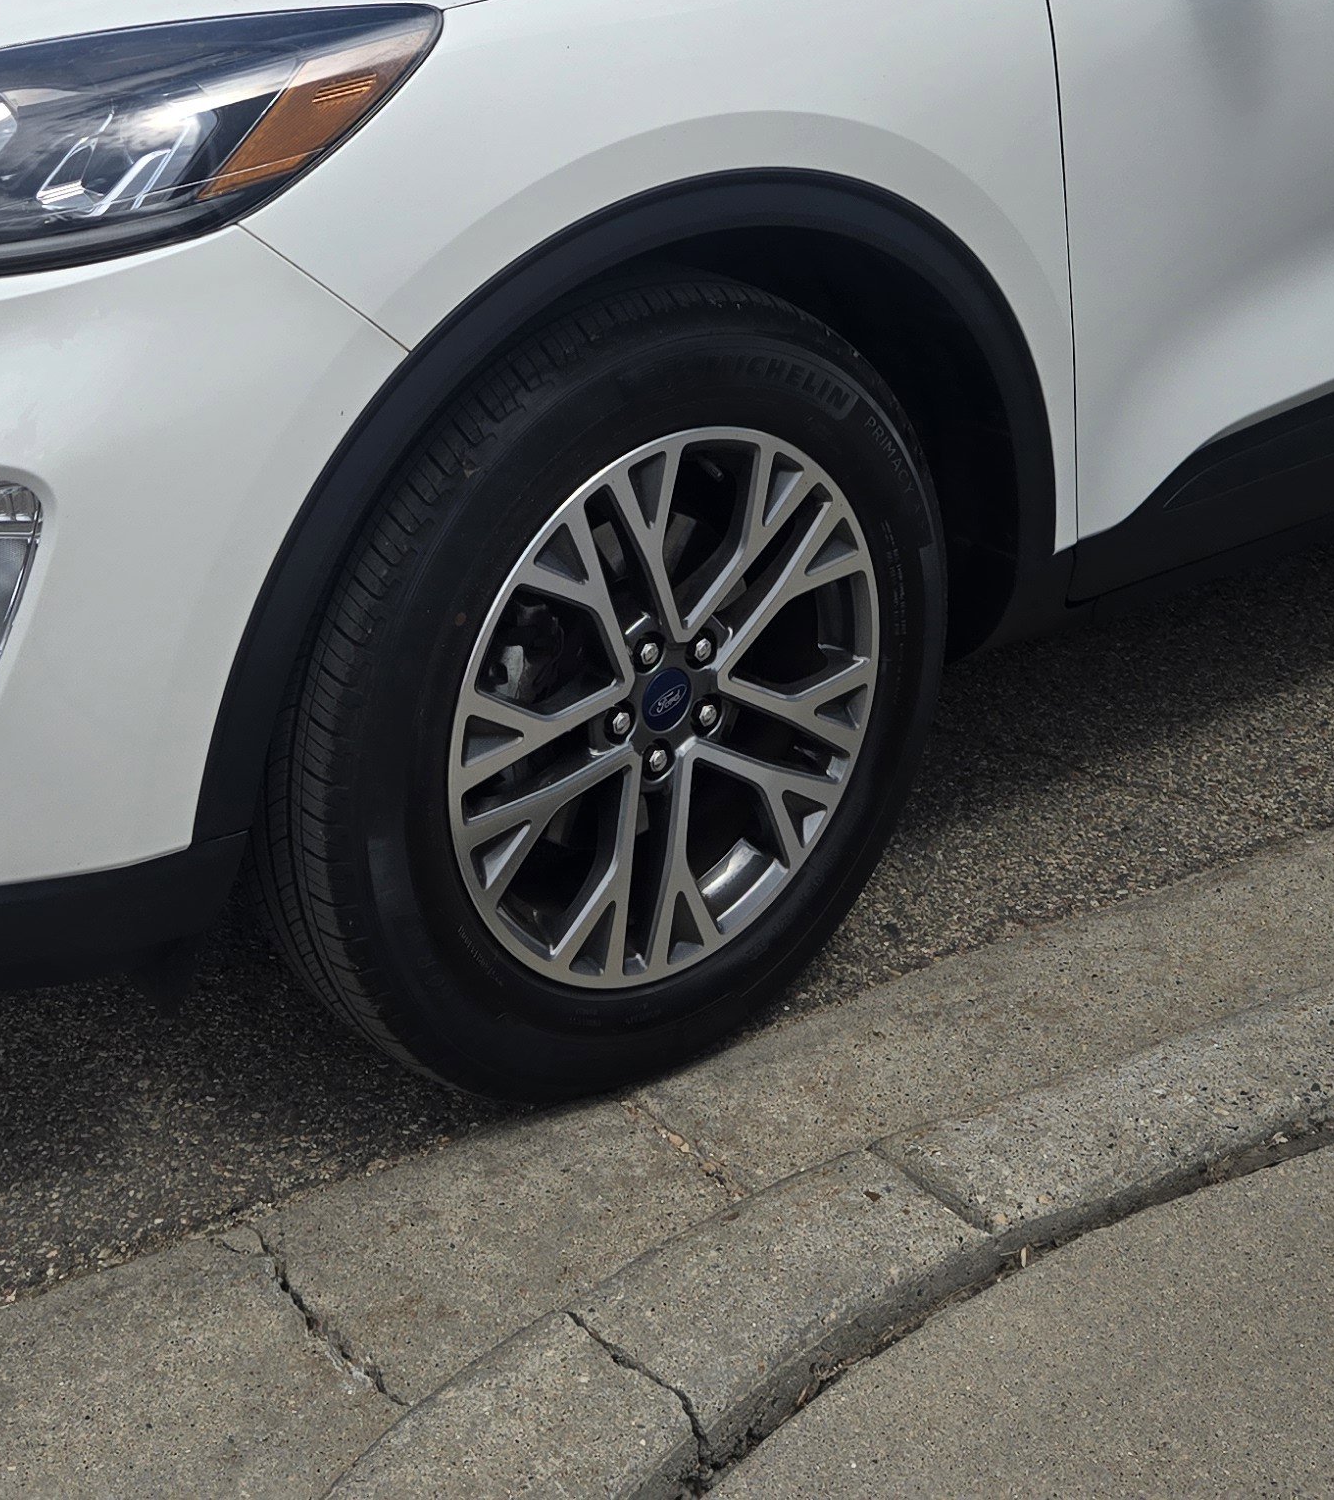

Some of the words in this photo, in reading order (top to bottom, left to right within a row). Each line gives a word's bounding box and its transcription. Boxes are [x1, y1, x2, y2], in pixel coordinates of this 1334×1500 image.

[699, 354, 851, 411] MICHELIN
[863, 414, 917, 496] PRIMACY
[656, 689, 681, 714] Ford
